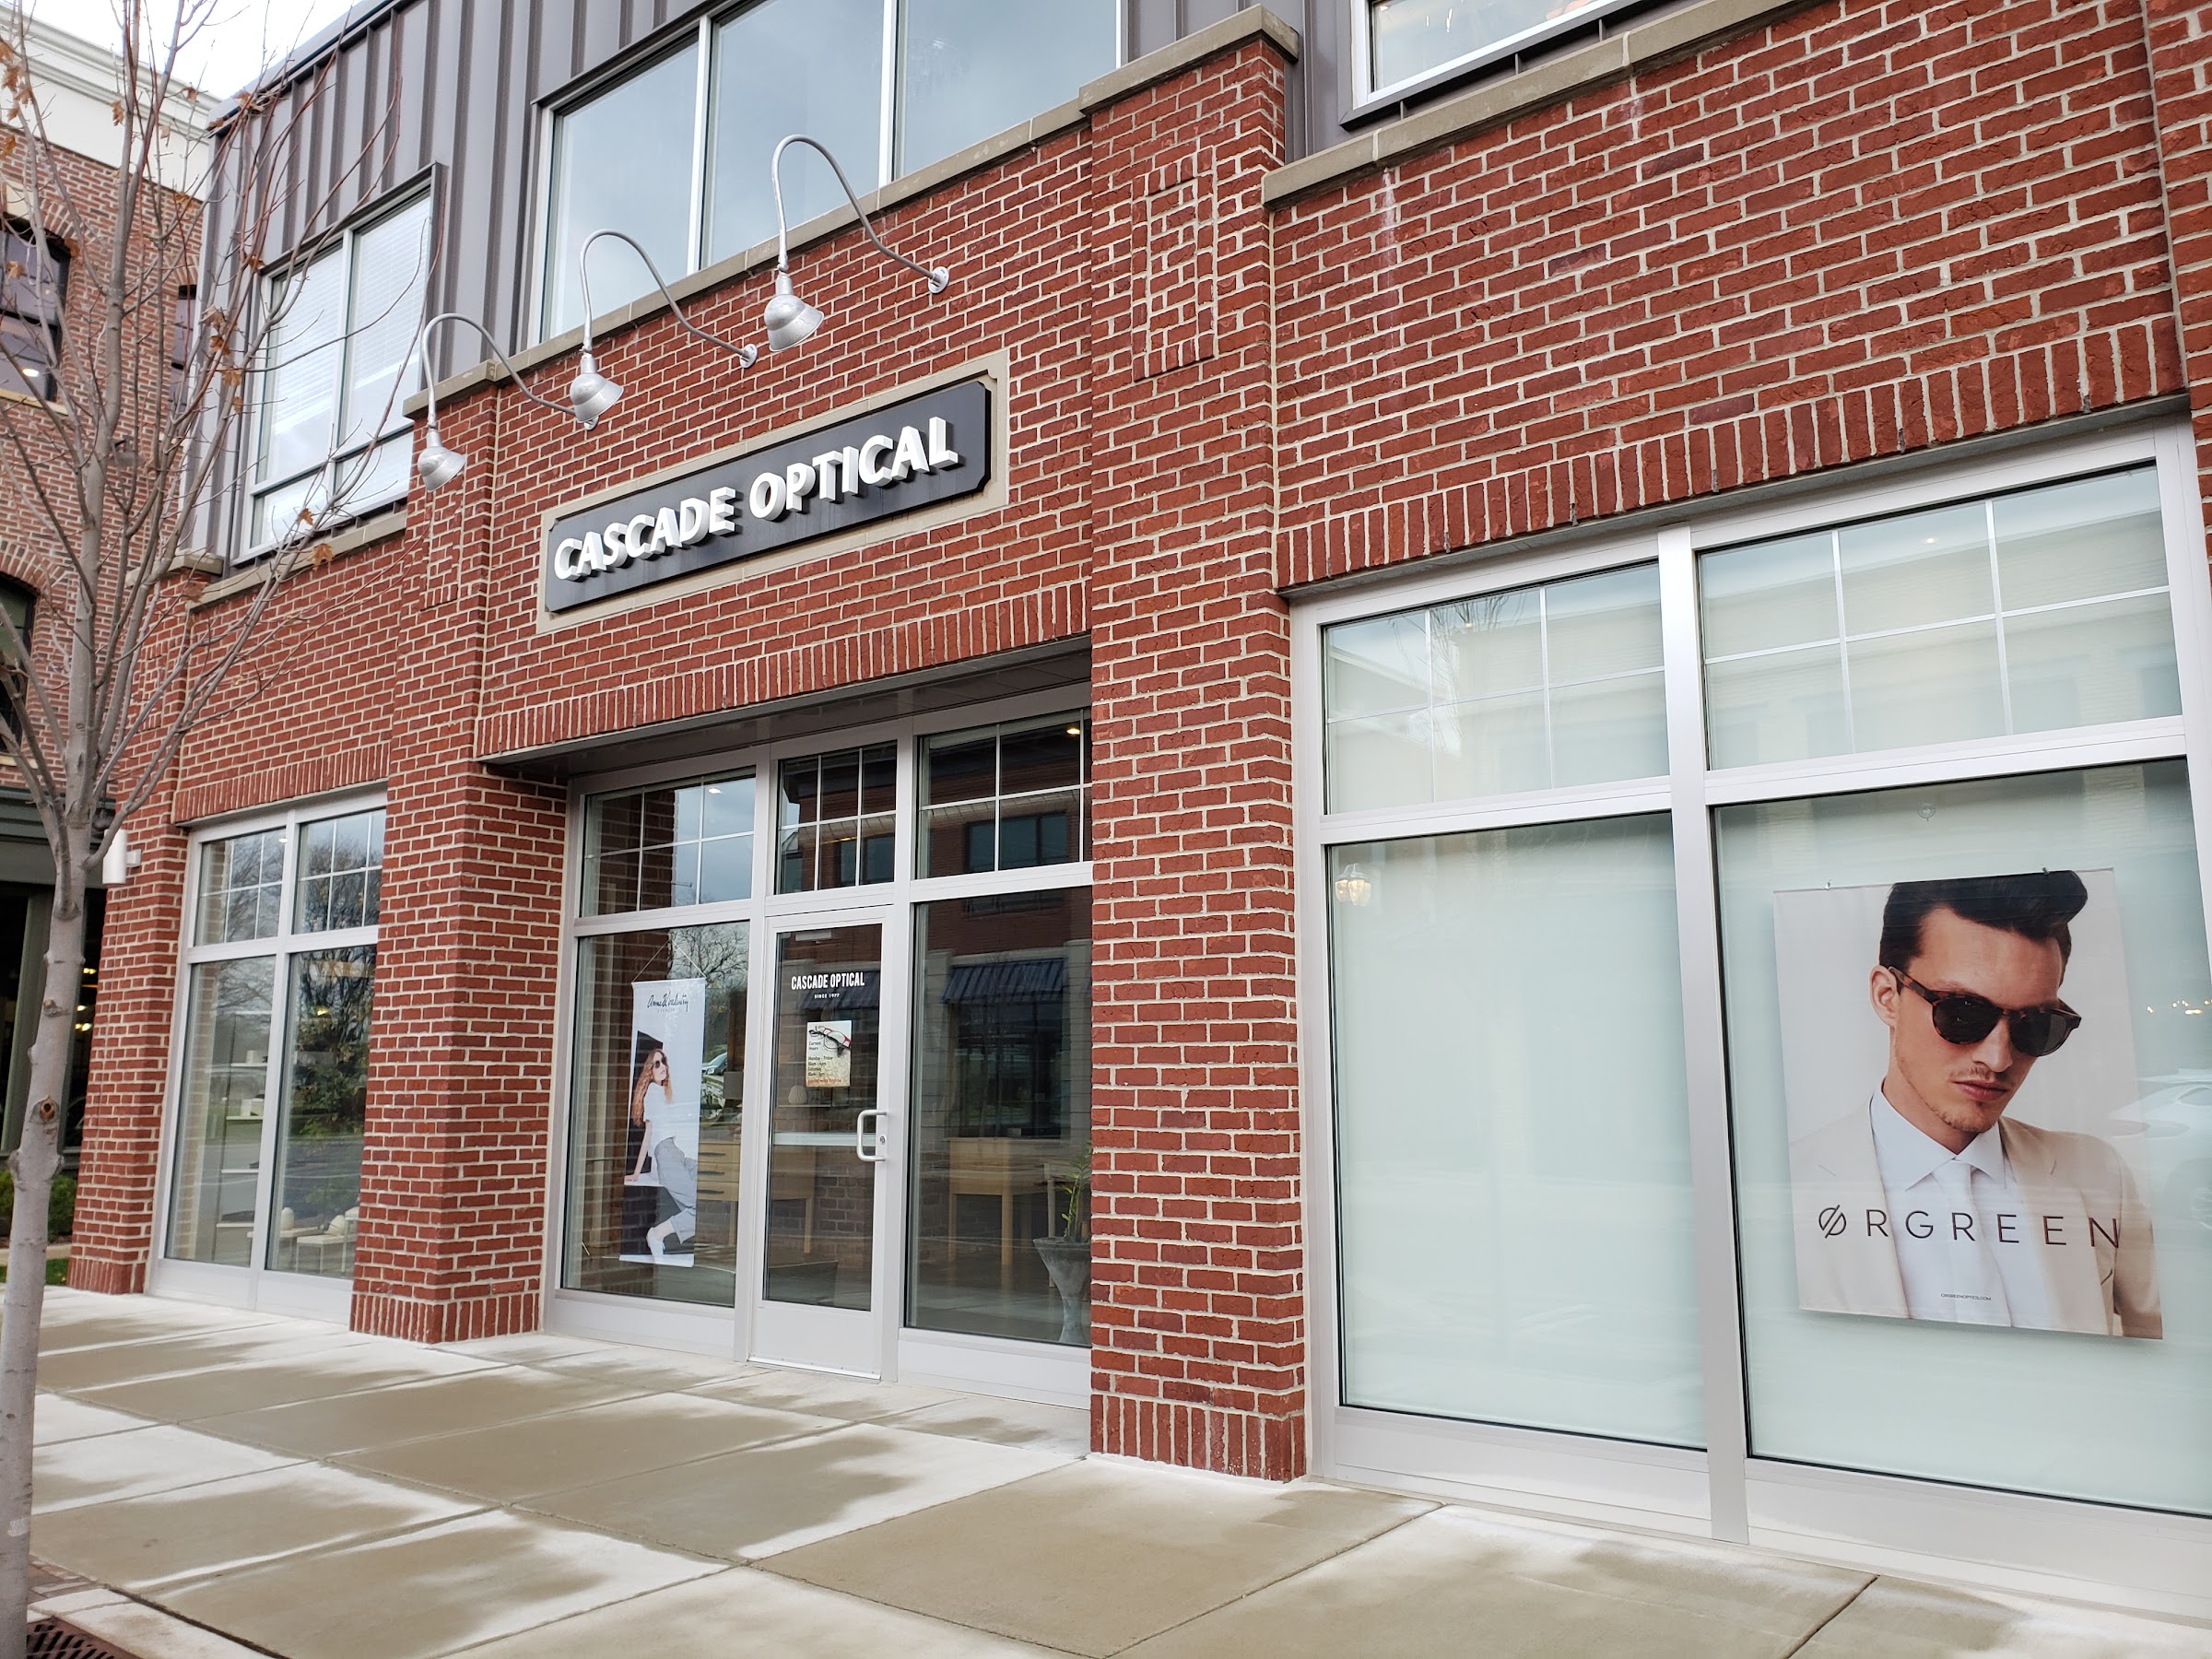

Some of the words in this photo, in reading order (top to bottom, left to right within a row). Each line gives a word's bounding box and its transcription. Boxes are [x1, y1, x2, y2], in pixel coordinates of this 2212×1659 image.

[554, 486, 736, 582] CASCADE
[748, 416, 959, 522] OPTICAL
[791, 974, 829, 991] CASCADE
[830, 971, 865, 988] OPTICAL
